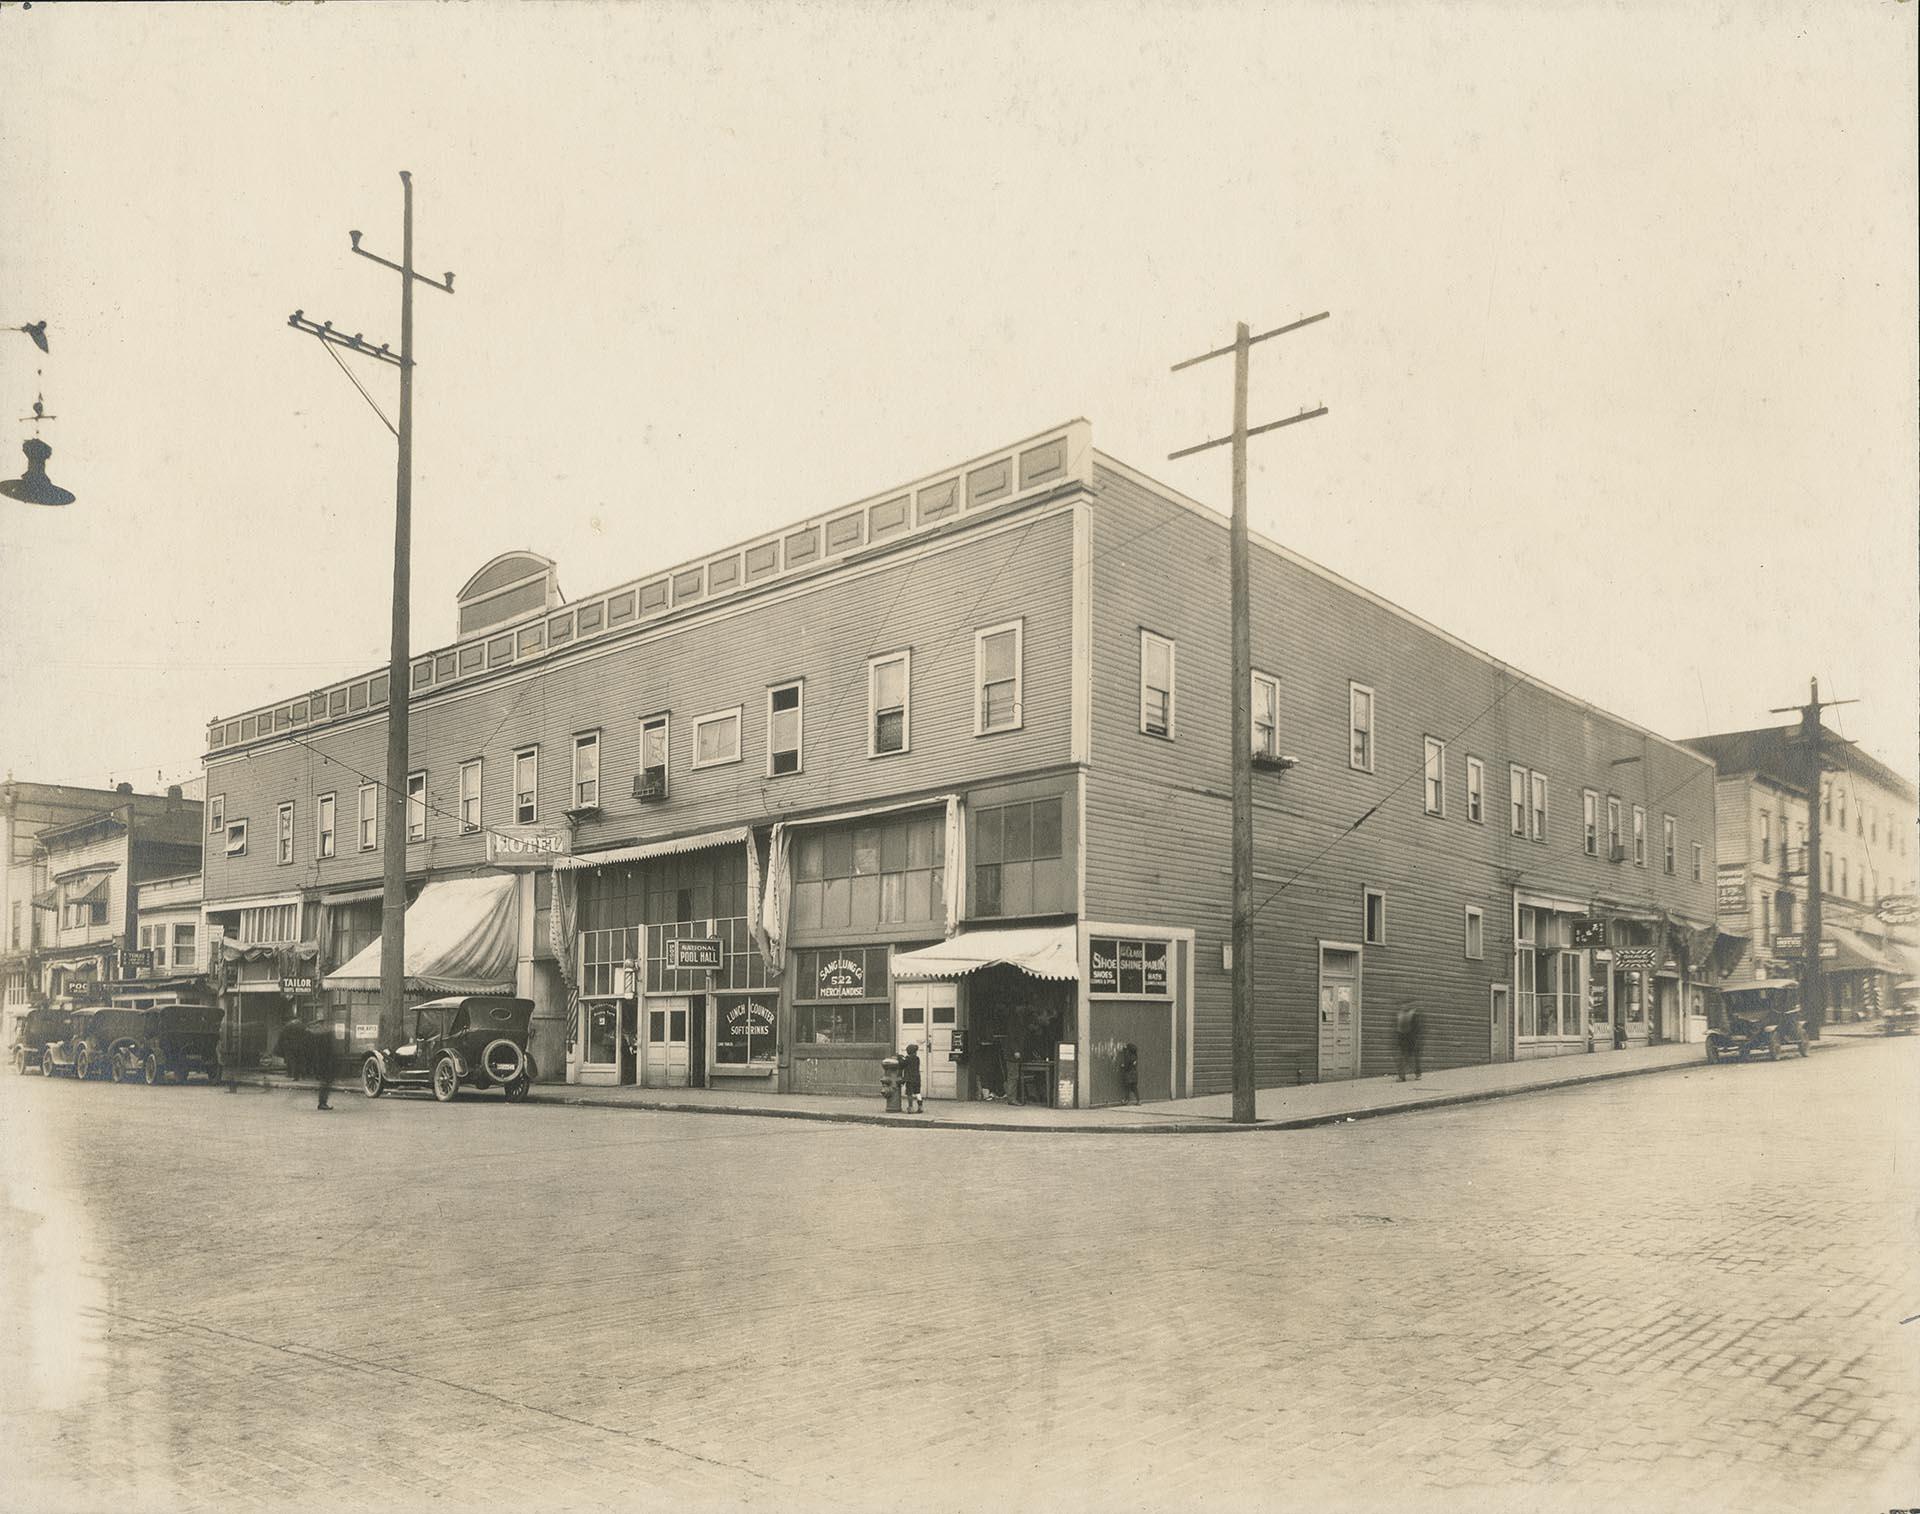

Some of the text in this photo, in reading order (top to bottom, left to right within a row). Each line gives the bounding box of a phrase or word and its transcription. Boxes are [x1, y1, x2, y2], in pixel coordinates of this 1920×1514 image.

[495, 834, 564, 853] HOTEL
[680, 951, 718, 963] POOL HALL
[1092, 952, 1117, 969] SHOE
[1120, 960, 1143, 970] SHINE
[820, 960, 838, 981] SANG
[838, 960, 858, 973] LUNG
[1093, 971, 1113, 979] SHOES
[831, 975, 852, 985] 522
[1147, 973, 1162, 981] HATS
[283, 978, 312, 988] TAILOR
[820, 987, 864, 997] MERCHANDISE
[726, 1003, 775, 1025] LUNCH COUNTER
[730, 1025, 769, 1035] SOFT DRINKS
